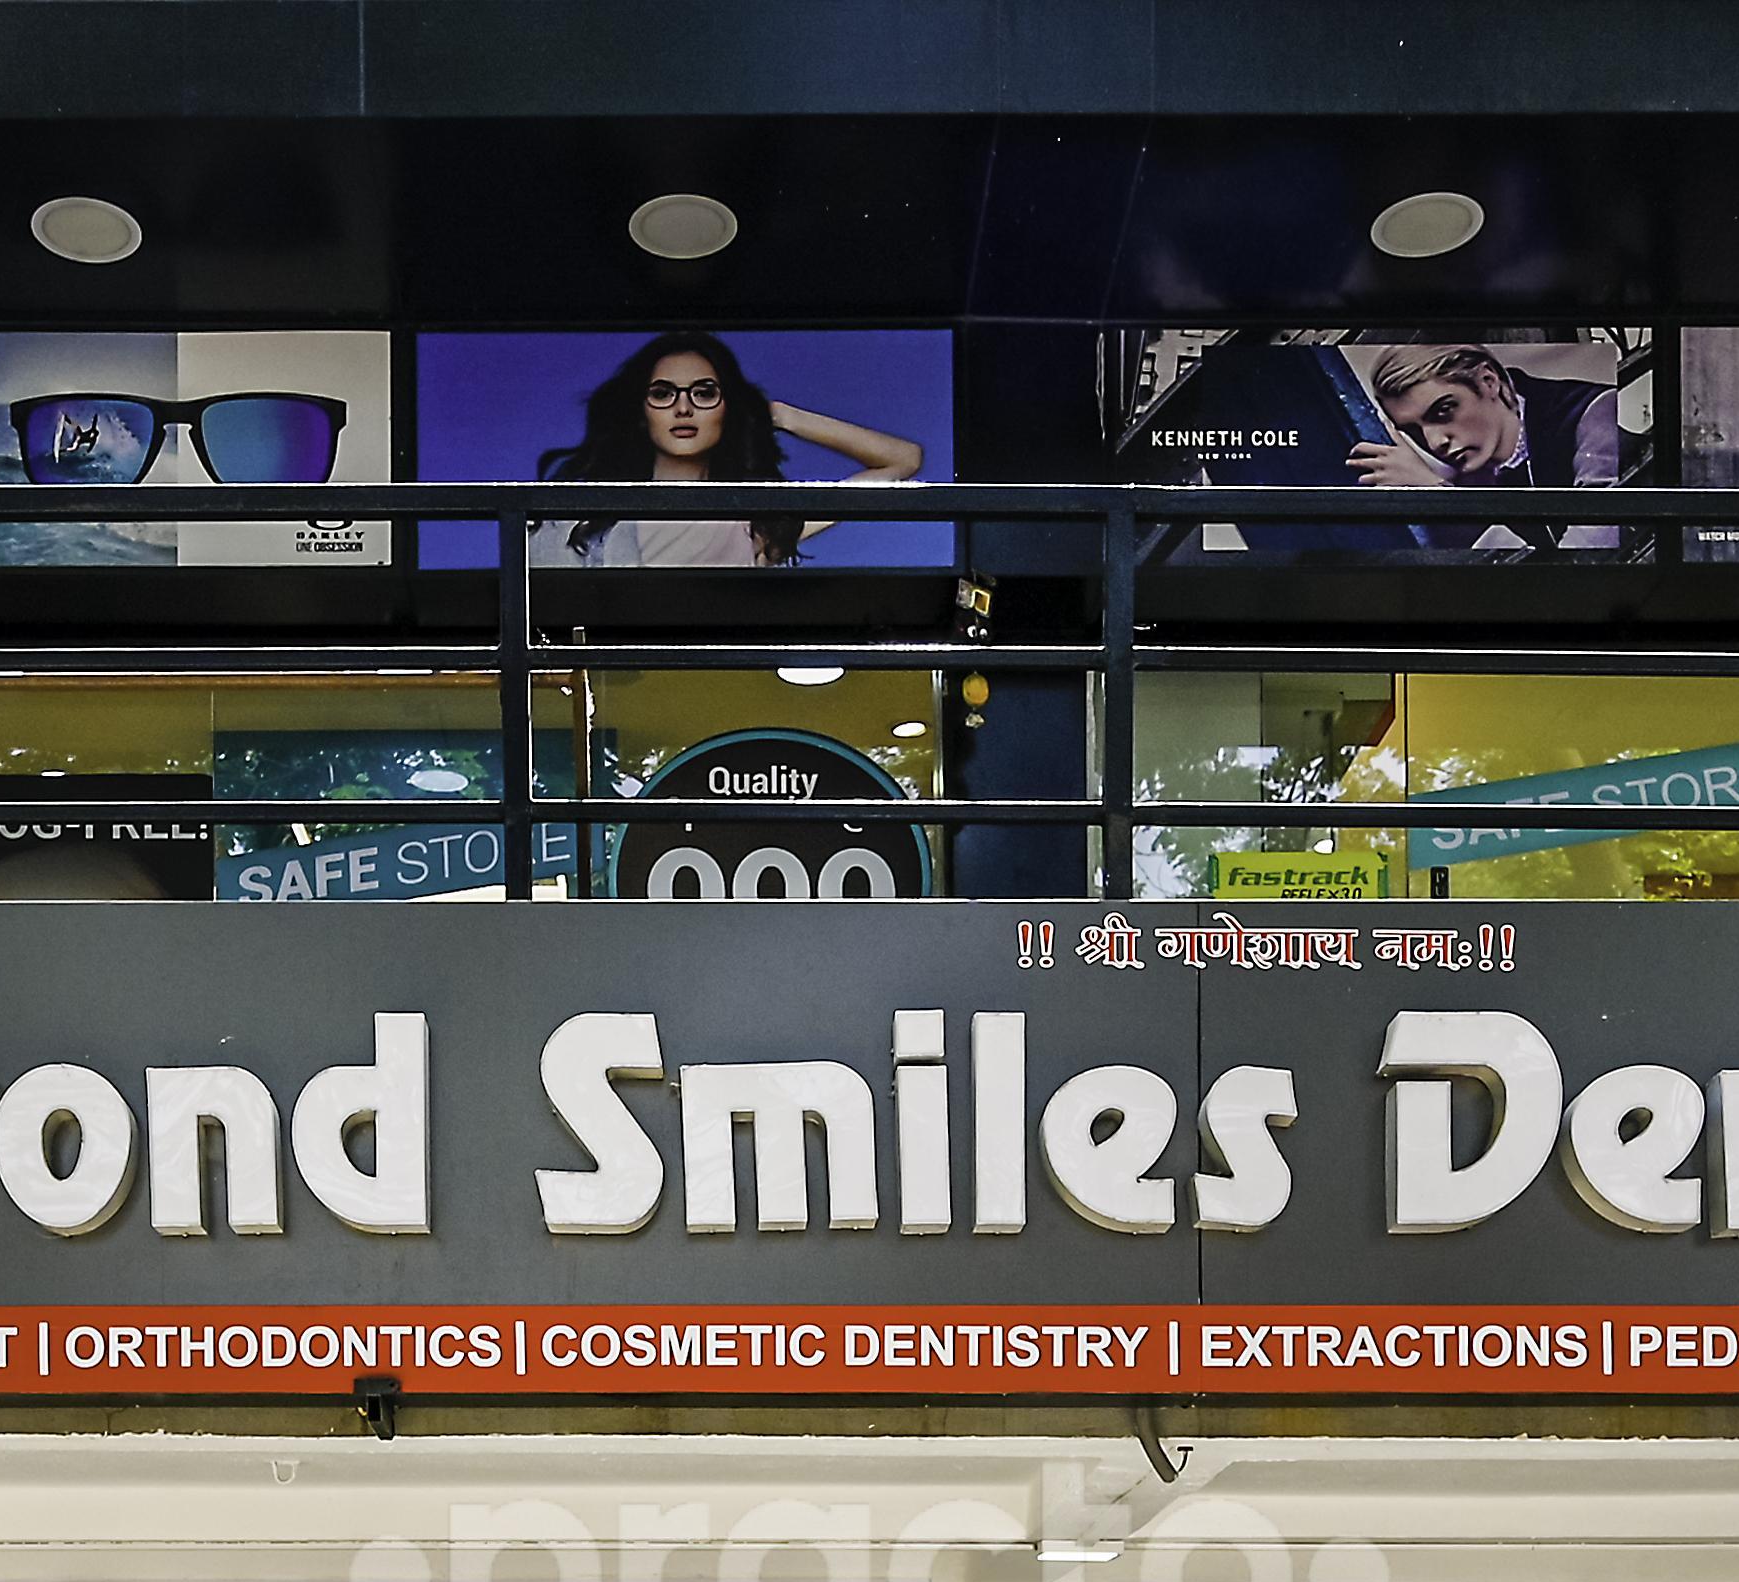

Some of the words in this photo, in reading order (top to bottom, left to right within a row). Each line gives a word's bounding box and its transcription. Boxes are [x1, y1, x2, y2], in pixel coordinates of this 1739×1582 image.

[1151, 430, 1243, 446] KENNETH
[1251, 430, 1299, 446] COLE
[708, 765, 819, 798] Quality
[238, 847, 380, 901] SAFE
[397, 824, 571, 884] STOE
[1228, 867, 1370, 887] fastrack
[1075, 912, 1143, 969] श्री
[533, 1007, 1299, 1236] Smiles
[64, 1325, 501, 1367] ORTHODONTICS
[540, 1325, 825, 1367] COSMETIC
[843, 1325, 1149, 1367] DENTISTRY
[1200, 1325, 1588, 1367] EXTRACTIONS
